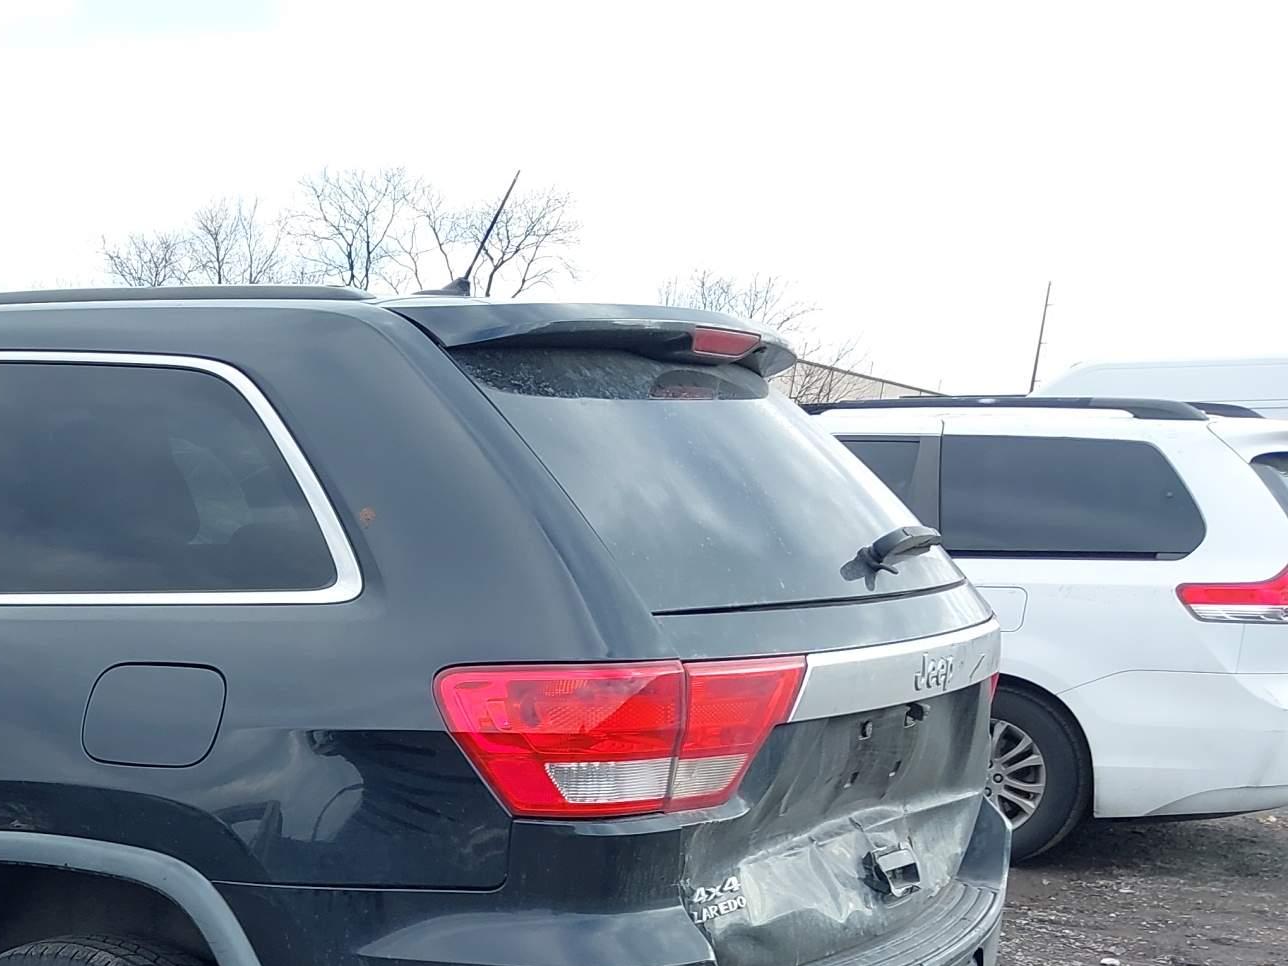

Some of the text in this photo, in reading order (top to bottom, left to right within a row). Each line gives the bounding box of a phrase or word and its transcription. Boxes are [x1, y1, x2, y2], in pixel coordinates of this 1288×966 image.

[912, 652, 953, 691] Jeep
[692, 876, 742, 903] 4x4
[690, 895, 746, 924] LAREDO
